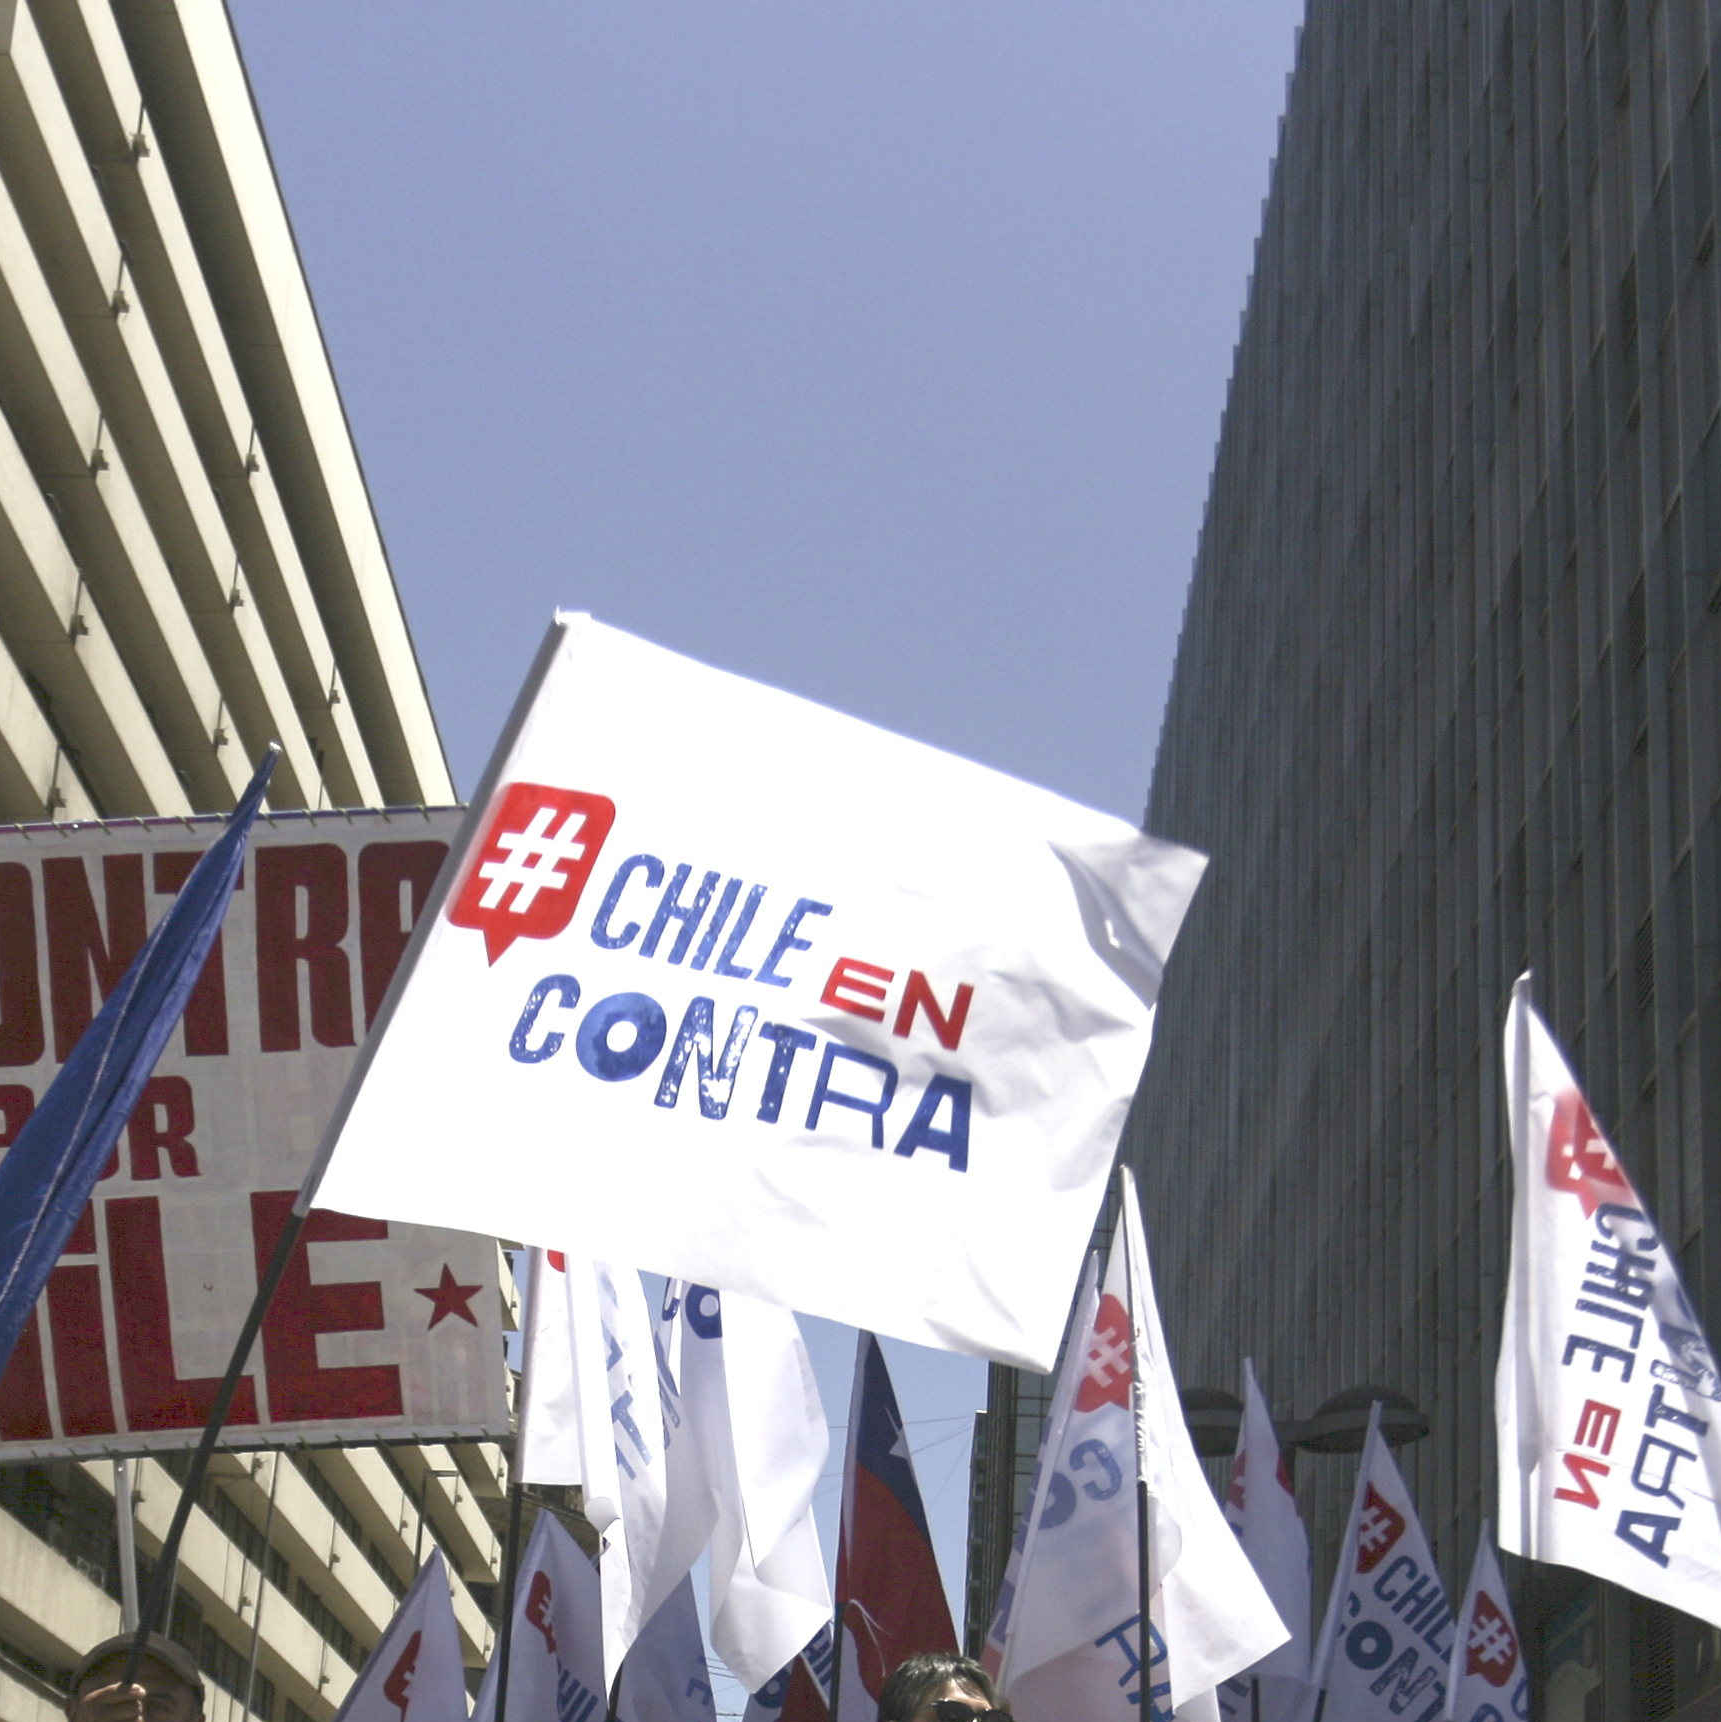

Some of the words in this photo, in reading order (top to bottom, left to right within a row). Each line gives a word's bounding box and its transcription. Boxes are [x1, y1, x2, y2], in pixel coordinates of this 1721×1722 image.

[819, 956, 974, 1052] EN
[508, 973, 973, 1173] CONTRA
[1374, 1555, 1456, 1668] CHIL
